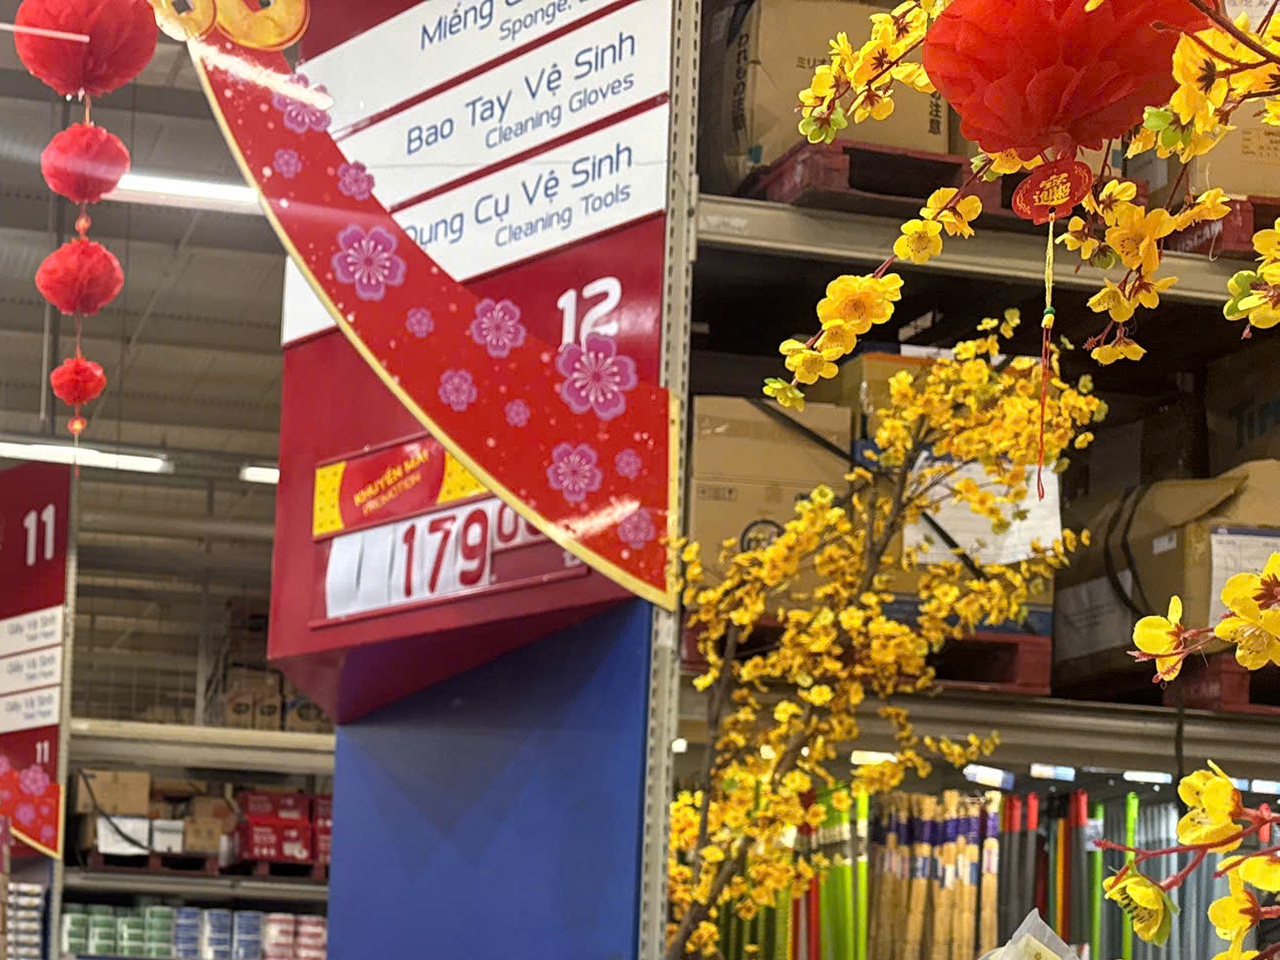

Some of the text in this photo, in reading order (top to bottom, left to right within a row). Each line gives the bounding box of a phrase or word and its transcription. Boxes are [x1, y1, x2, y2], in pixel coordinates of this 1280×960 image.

[406, 31, 636, 156] Bao Tay Vệ Sinh
[485, 73, 635, 149] Cleaning Gloves
[475, 193, 510, 224] Cụ
[521, 169, 560, 206] Vệ
[571, 142, 633, 189] Sinh
[495, 184, 631, 248] Cleaning Tools
[556, 276, 622, 350] 12
[23, 503, 56, 566] 11
[402, 508, 489, 598] 179
